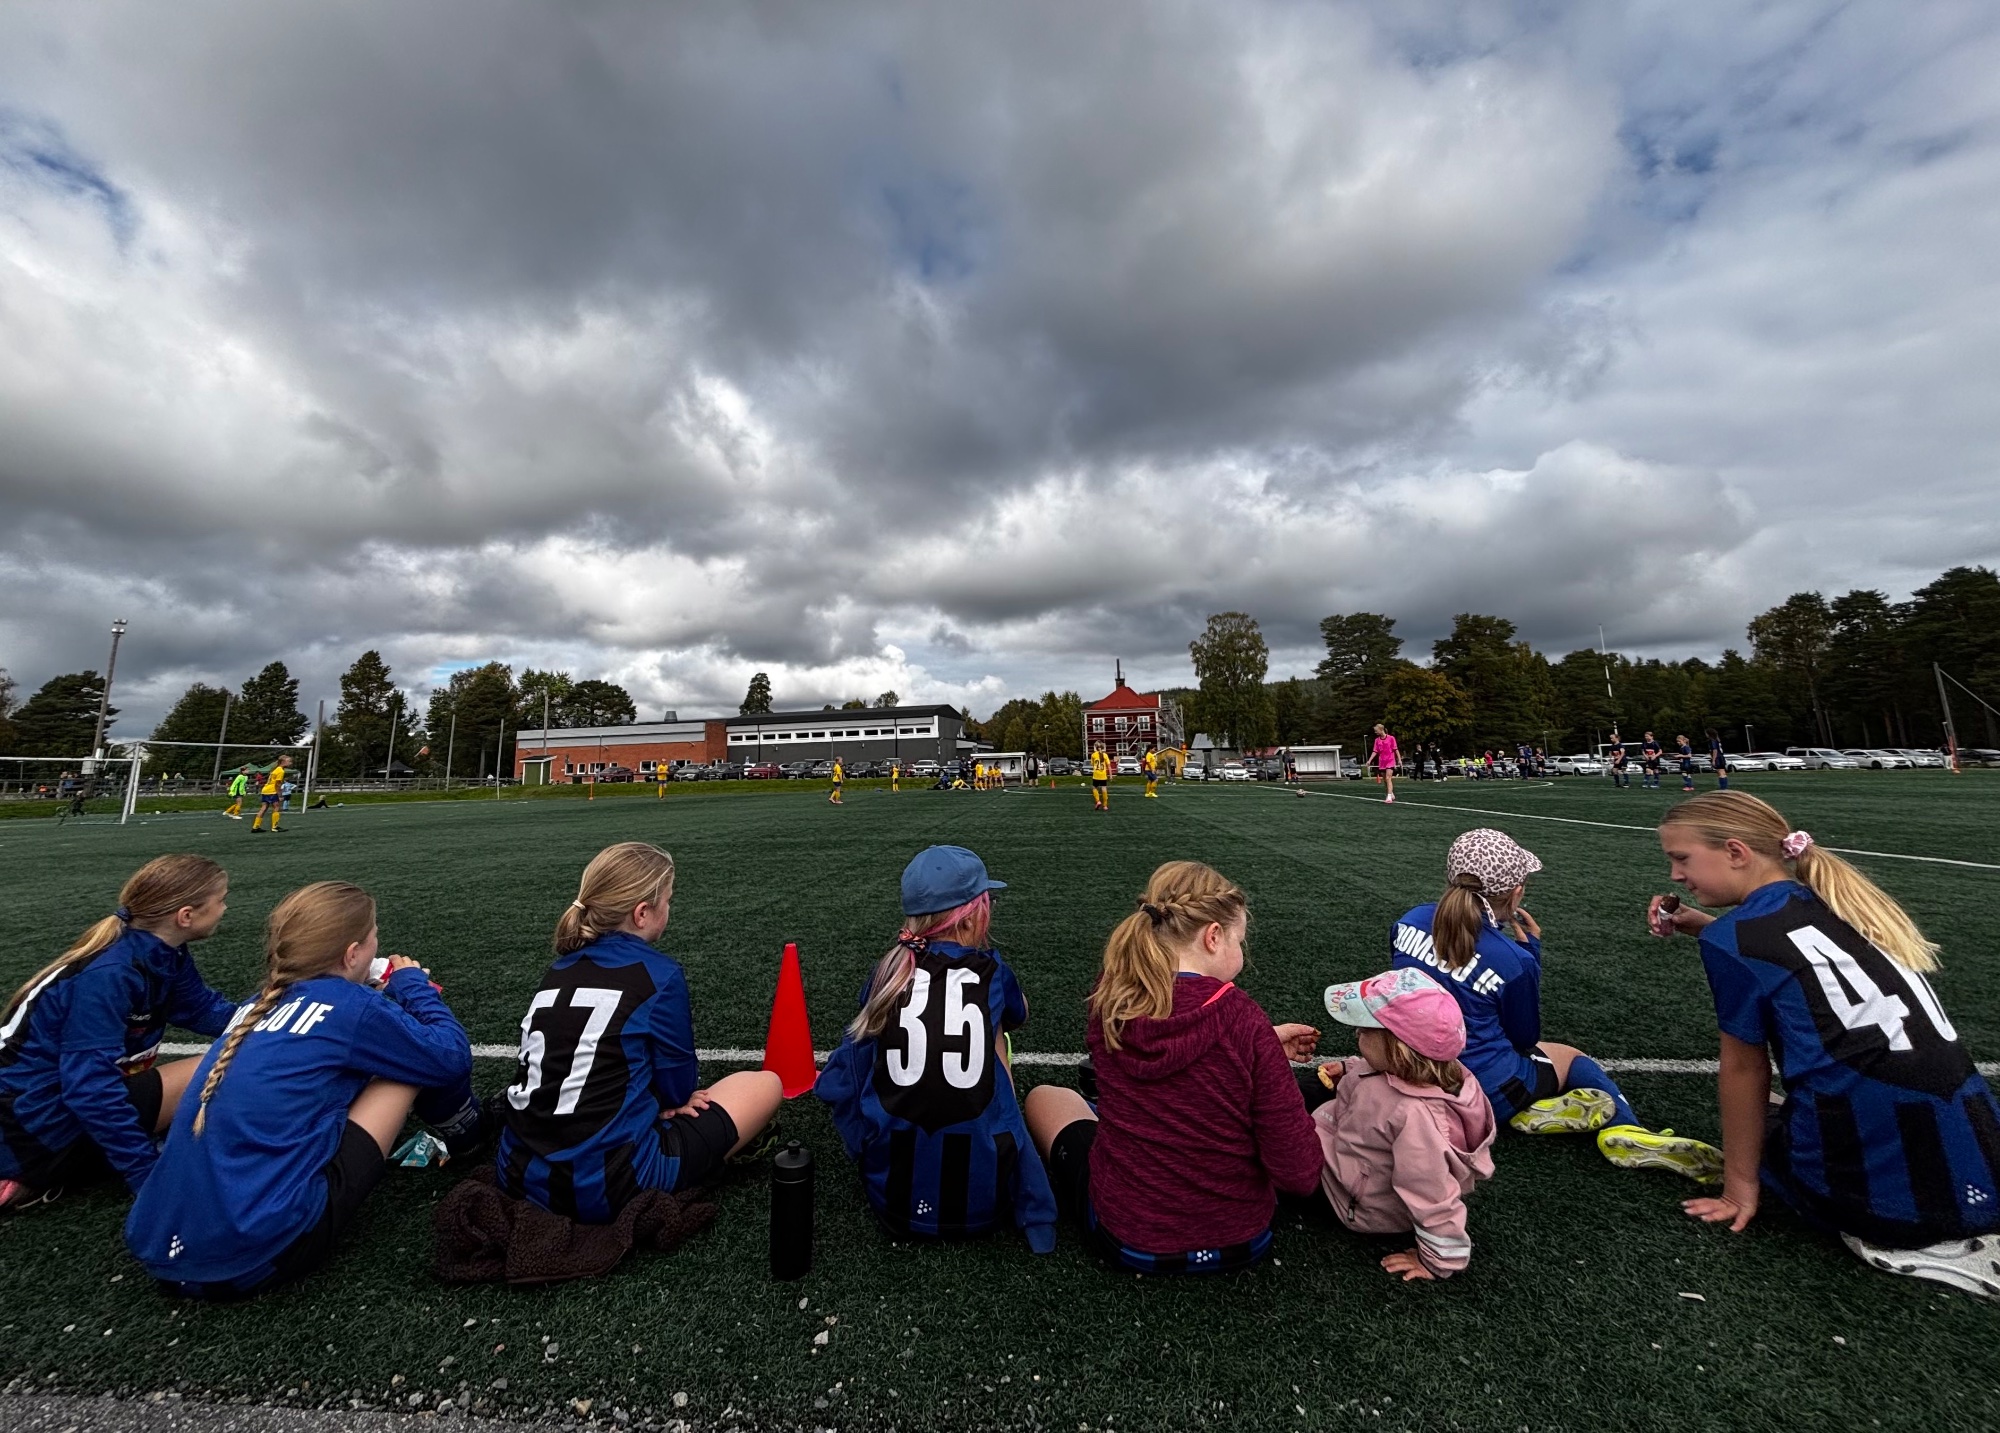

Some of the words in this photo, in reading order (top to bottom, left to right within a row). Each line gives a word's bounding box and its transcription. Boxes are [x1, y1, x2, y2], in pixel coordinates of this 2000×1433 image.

[288, 1001, 335, 1035] IF
[1472, 968, 1506, 996] IF
[507, 987, 623, 1115] 57
[886, 967, 985, 1089] 35
